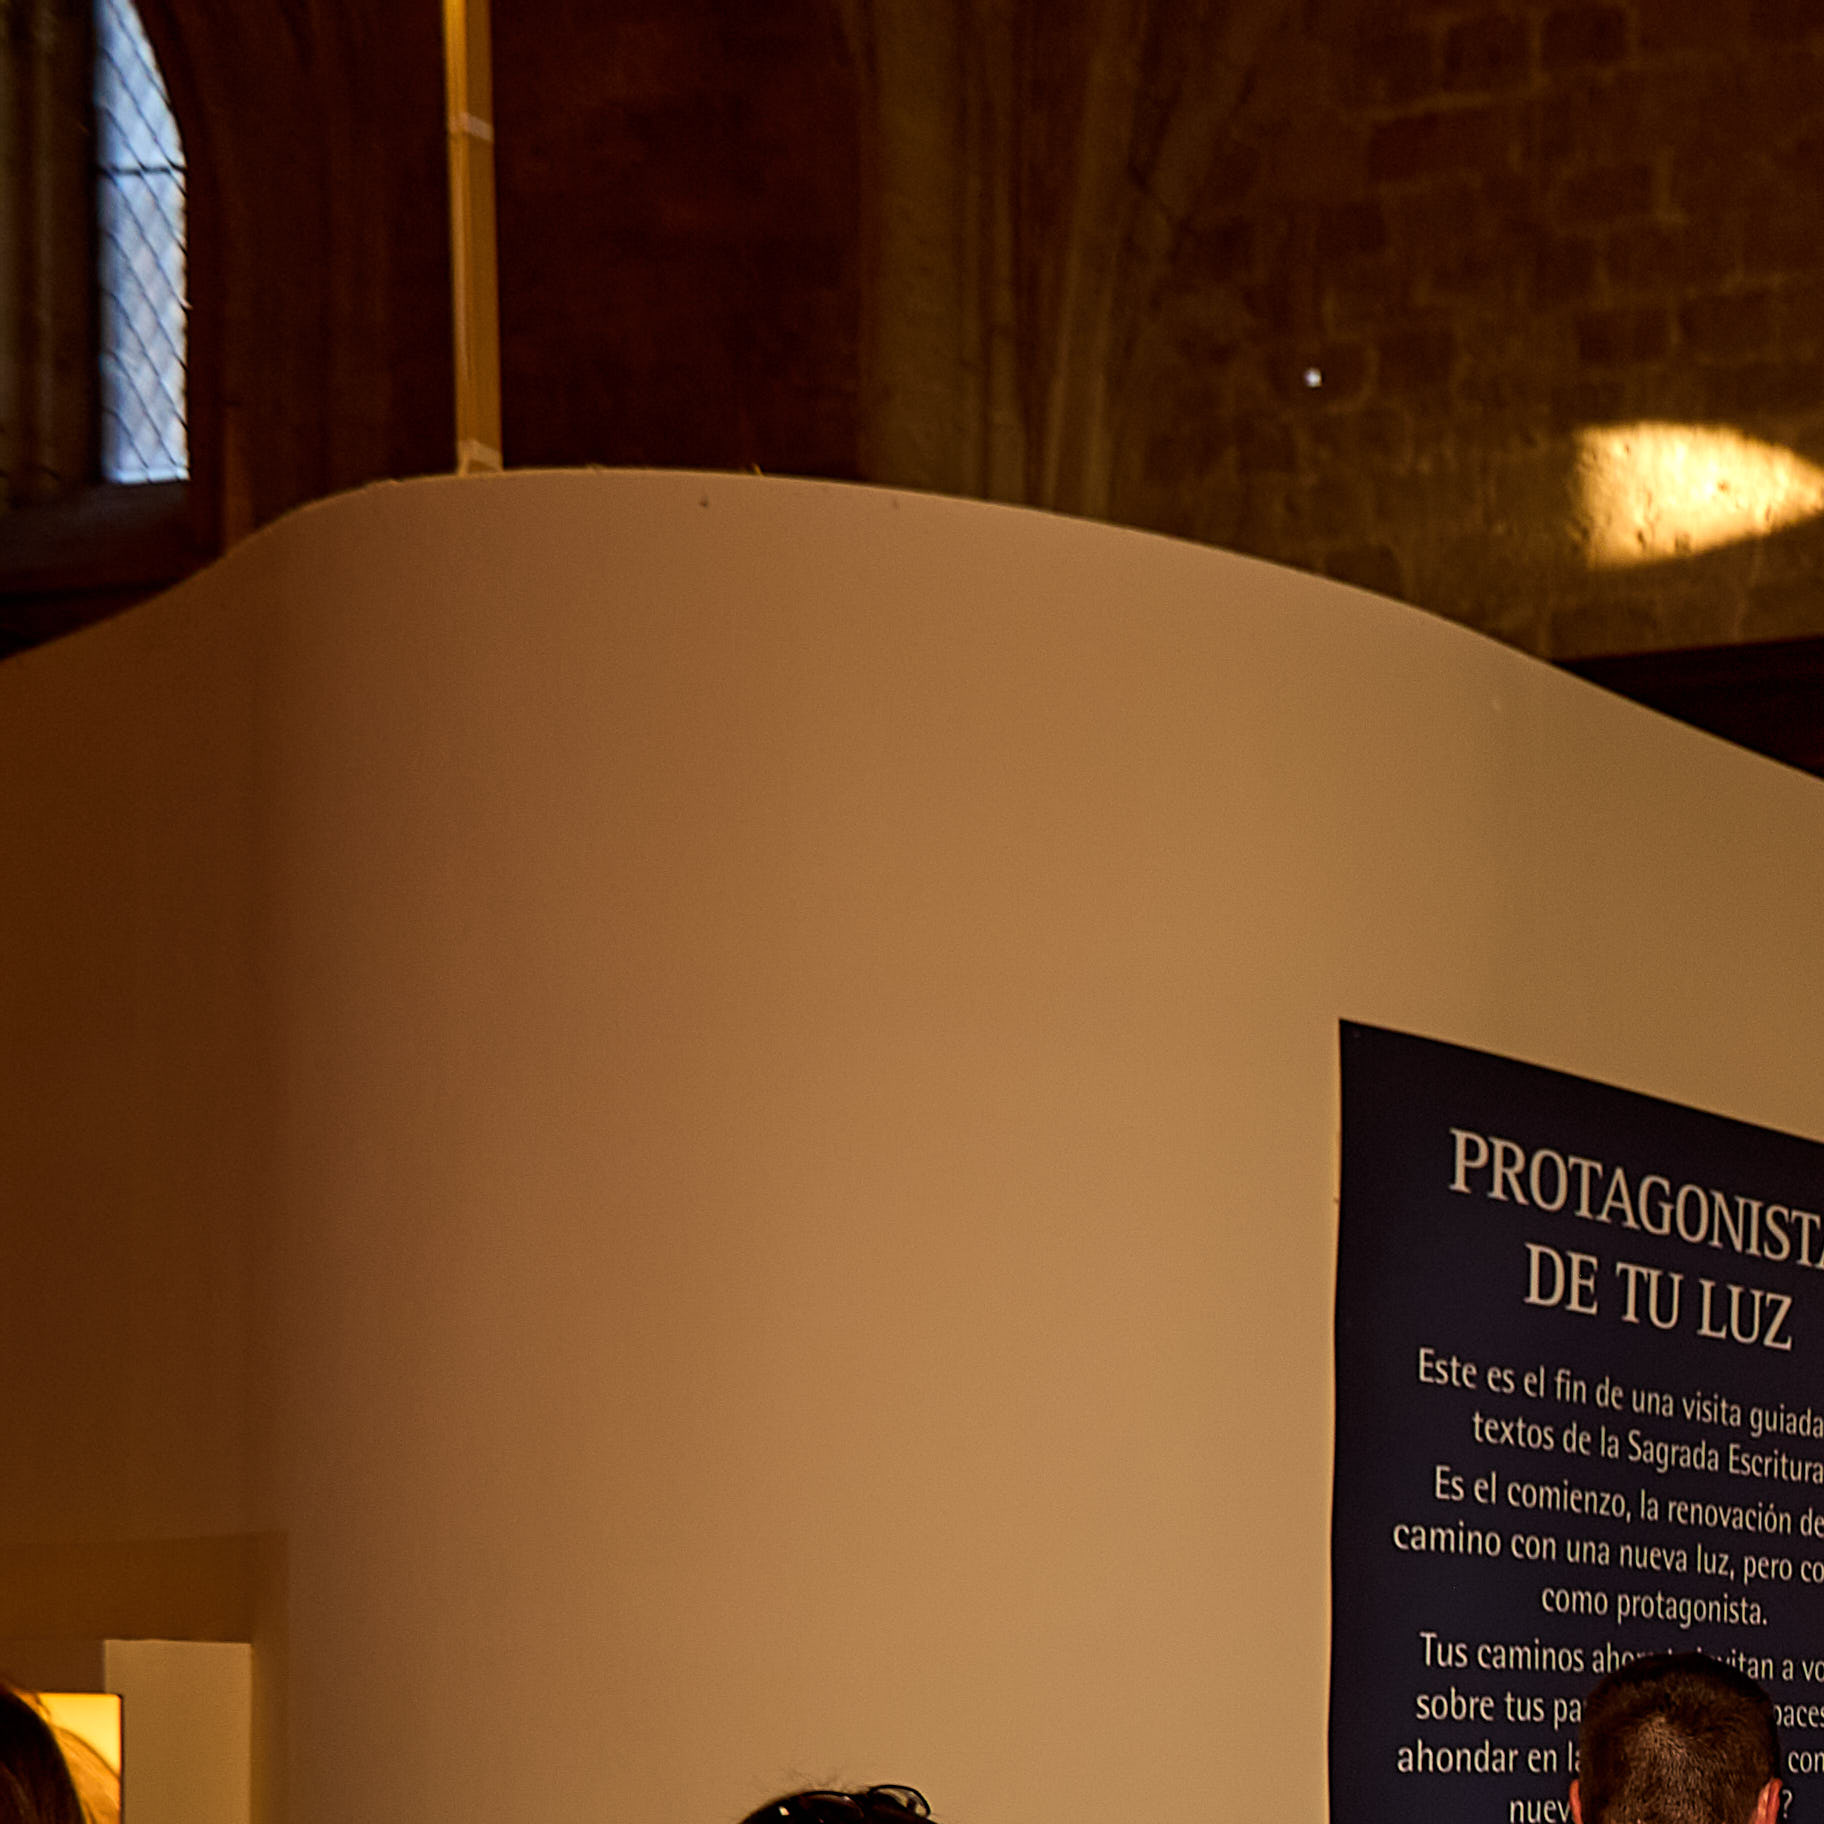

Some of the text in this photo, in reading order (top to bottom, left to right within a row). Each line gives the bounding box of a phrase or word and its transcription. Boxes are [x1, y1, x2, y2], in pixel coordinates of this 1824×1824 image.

[1524, 1242, 1793, 1351] DE TU LUZ
[1419, 1347, 1477, 1389] Este
[1487, 1366, 1515, 1394] es
[1524, 1365, 1545, 1398] el
[1555, 1368, 1587, 1404] fin
[1596, 1376, 1623, 1410] de
[1632, 1388, 1673, 1418] una
[1682, 1391, 1741, 1428] visita
[1750, 1403, 1824, 1438] guiada
[1472, 1411, 1555, 1450] textos
[1563, 1421, 1591, 1456] de
[1601, 1425, 1620, 1459] la
[1628, 1429, 1719, 1474] Sagrada
[1435, 1464, 1465, 1501] Es
[1474, 1471, 1497, 1505] el
[1507, 1479, 1631, 1524] comienzo,
[1640, 1488, 1659, 1521] la
[1668, 1501, 1792, 1535] renovación
[1393, 1520, 1501, 1558] camino
[1511, 1533, 1556, 1561] con
[1567, 1538, 1610, 1566] una
[1619, 1544, 1687, 1573] nueva
[1697, 1543, 1735, 1582] luz,
[1744, 1554, 1793, 1586] pero
[1541, 1587, 1767, 1629] como protagonista.
[1419, 1631, 1469, 1669] Tus
[1477, 1637, 1585, 1673] caminos
[1592, 1641, 1654, 1674] aho
[1782, 1659, 1795, 1681] a
[1416, 1686, 1495, 1722] sobre
[1504, 1691, 1545, 1723] tus
[1397, 1738, 1518, 1773] ahondar
[1527, 1747, 1557, 1774] en
